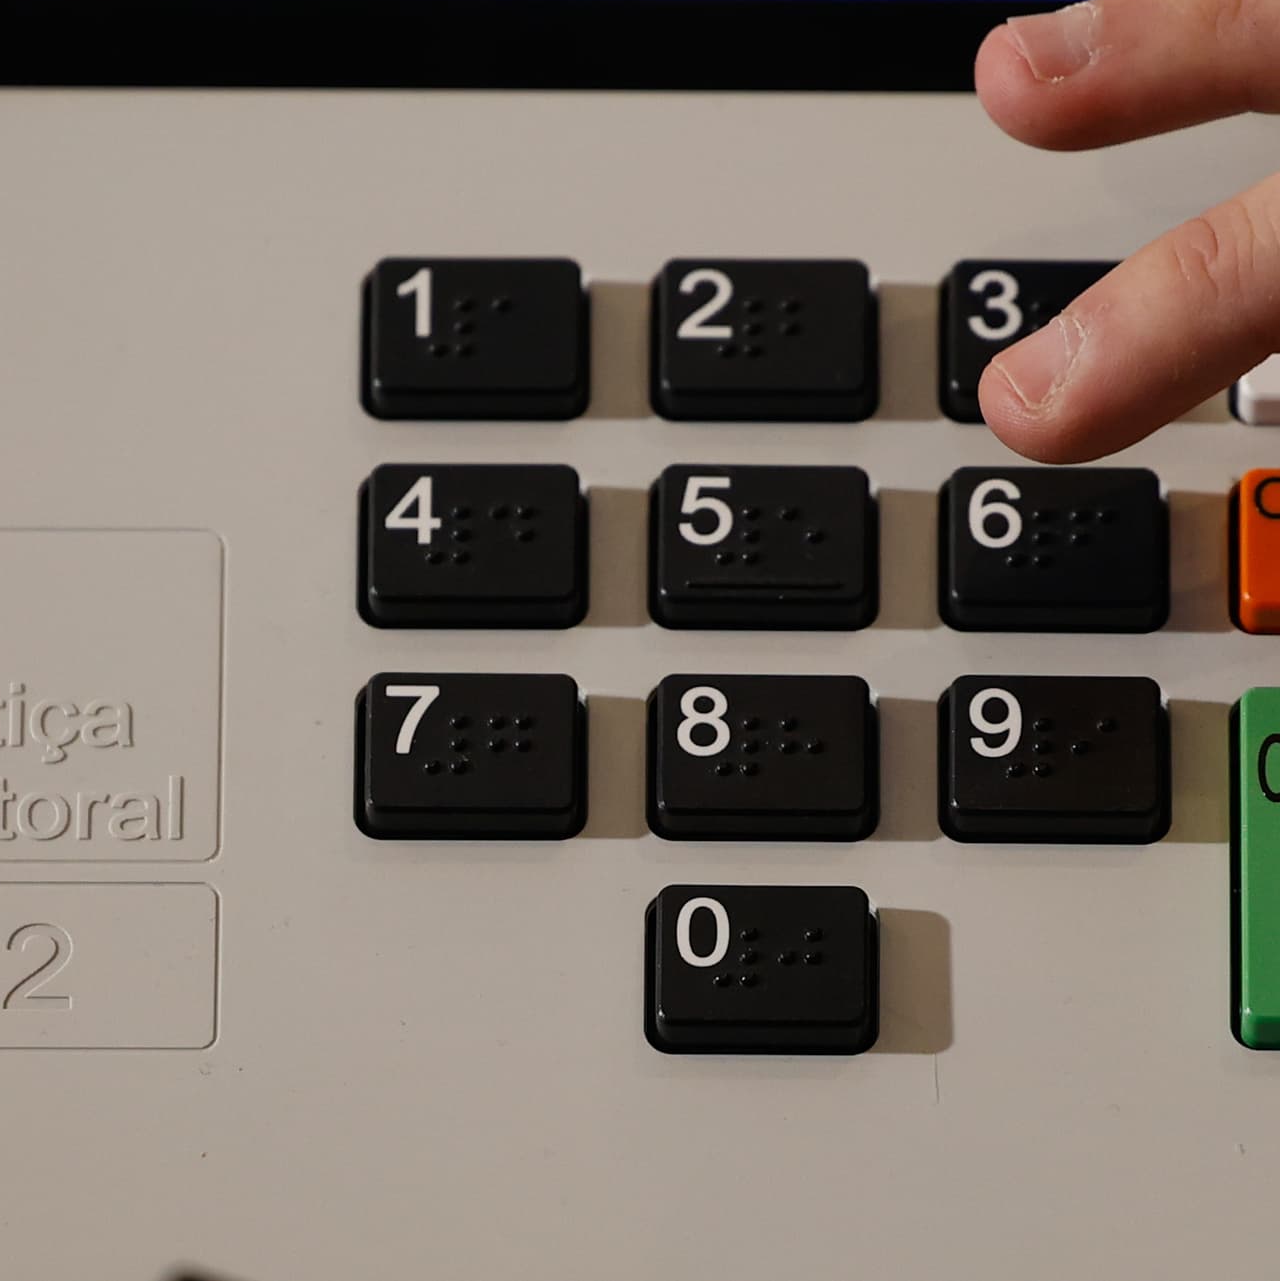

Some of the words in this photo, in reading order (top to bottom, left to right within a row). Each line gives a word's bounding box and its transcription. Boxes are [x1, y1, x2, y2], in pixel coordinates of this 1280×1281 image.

[397, 269, 431, 337] 1
[677, 269, 732, 338] 2
[969, 271, 1022, 340] 3
[385, 476, 442, 544] 4
[679, 476, 733, 545] 5
[968, 479, 1022, 548] 6
[385, 685, 440, 754] 7
[677, 686, 731, 757] 8
[969, 687, 1022, 758] 9
[676, 897, 730, 967] 0
